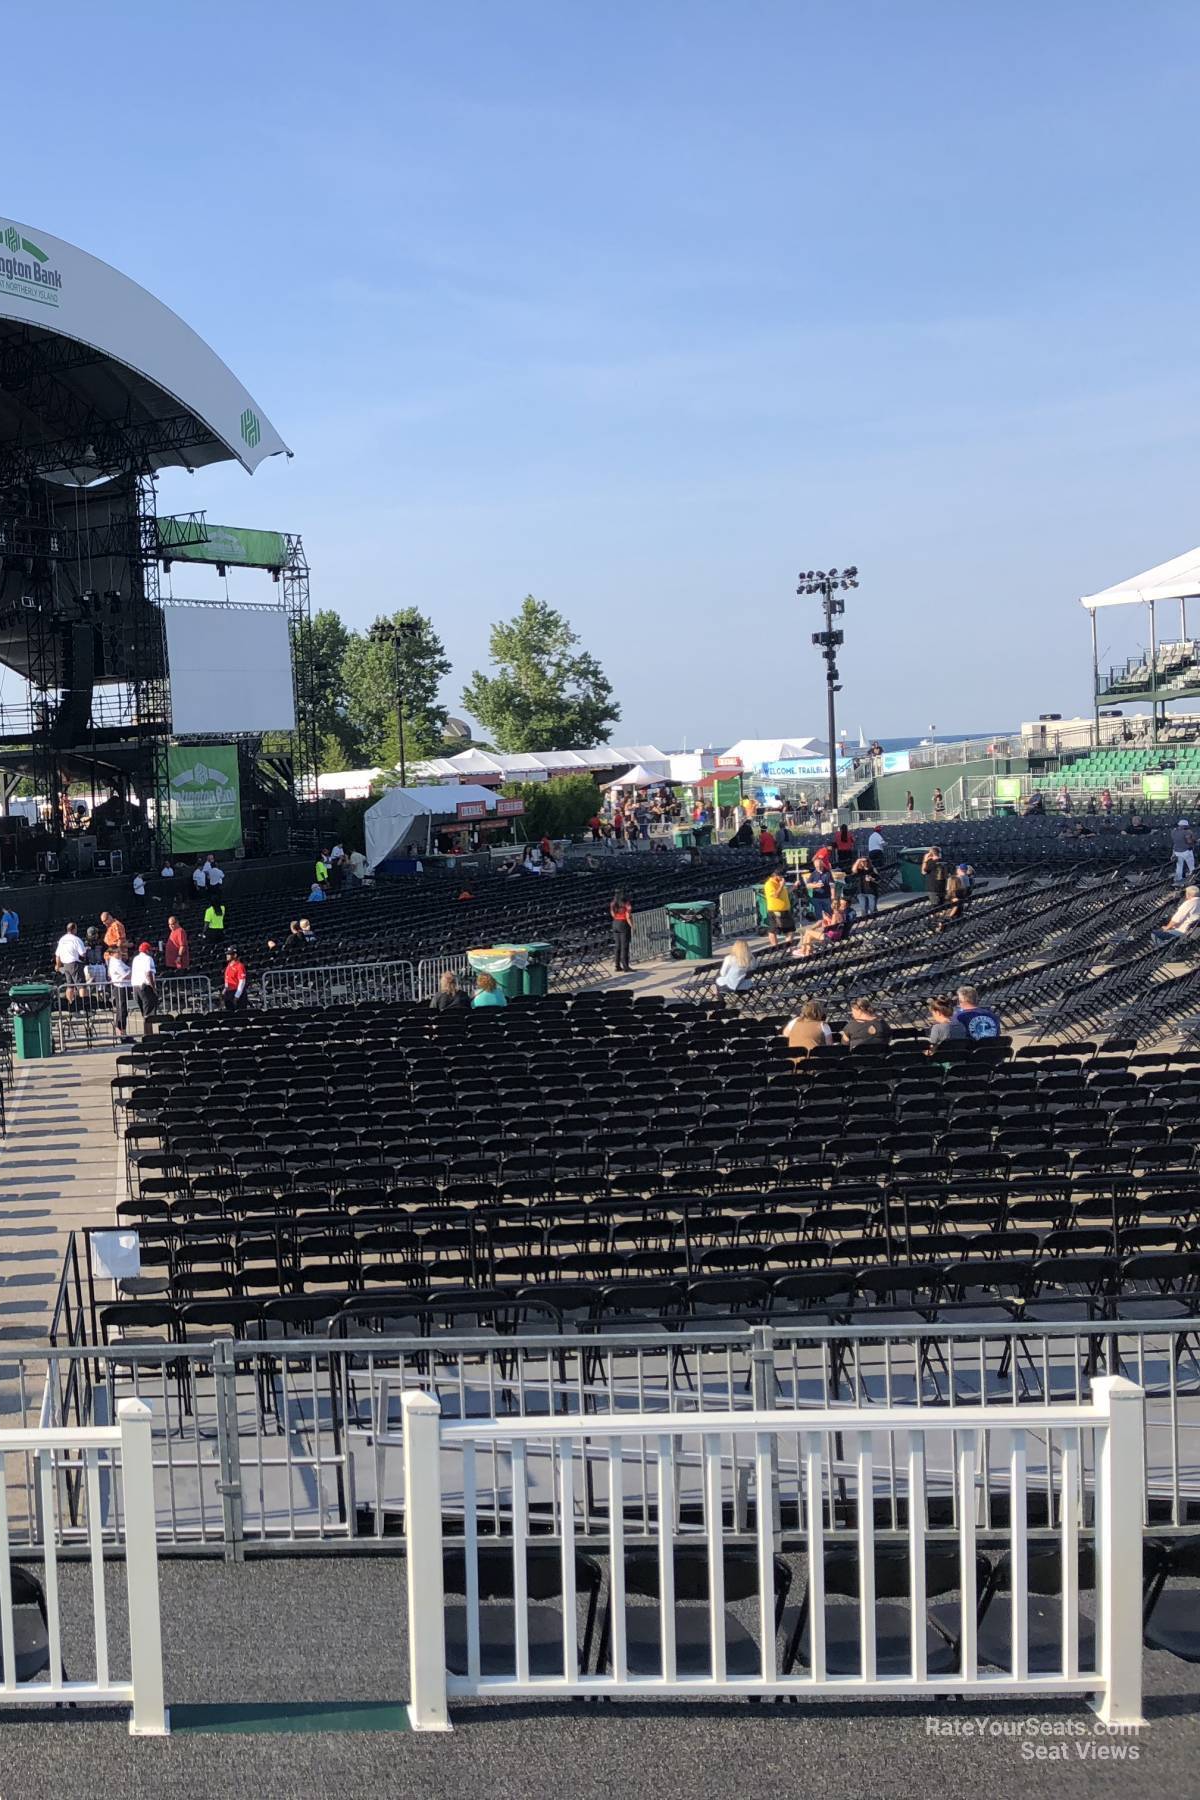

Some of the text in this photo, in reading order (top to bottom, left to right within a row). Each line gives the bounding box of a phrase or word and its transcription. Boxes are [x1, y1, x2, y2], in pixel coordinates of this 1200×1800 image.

[33, 261, 62, 288] Bank
[6, 281, 38, 297] NORTHERLY
[38, 289, 58, 302] ISLAND
